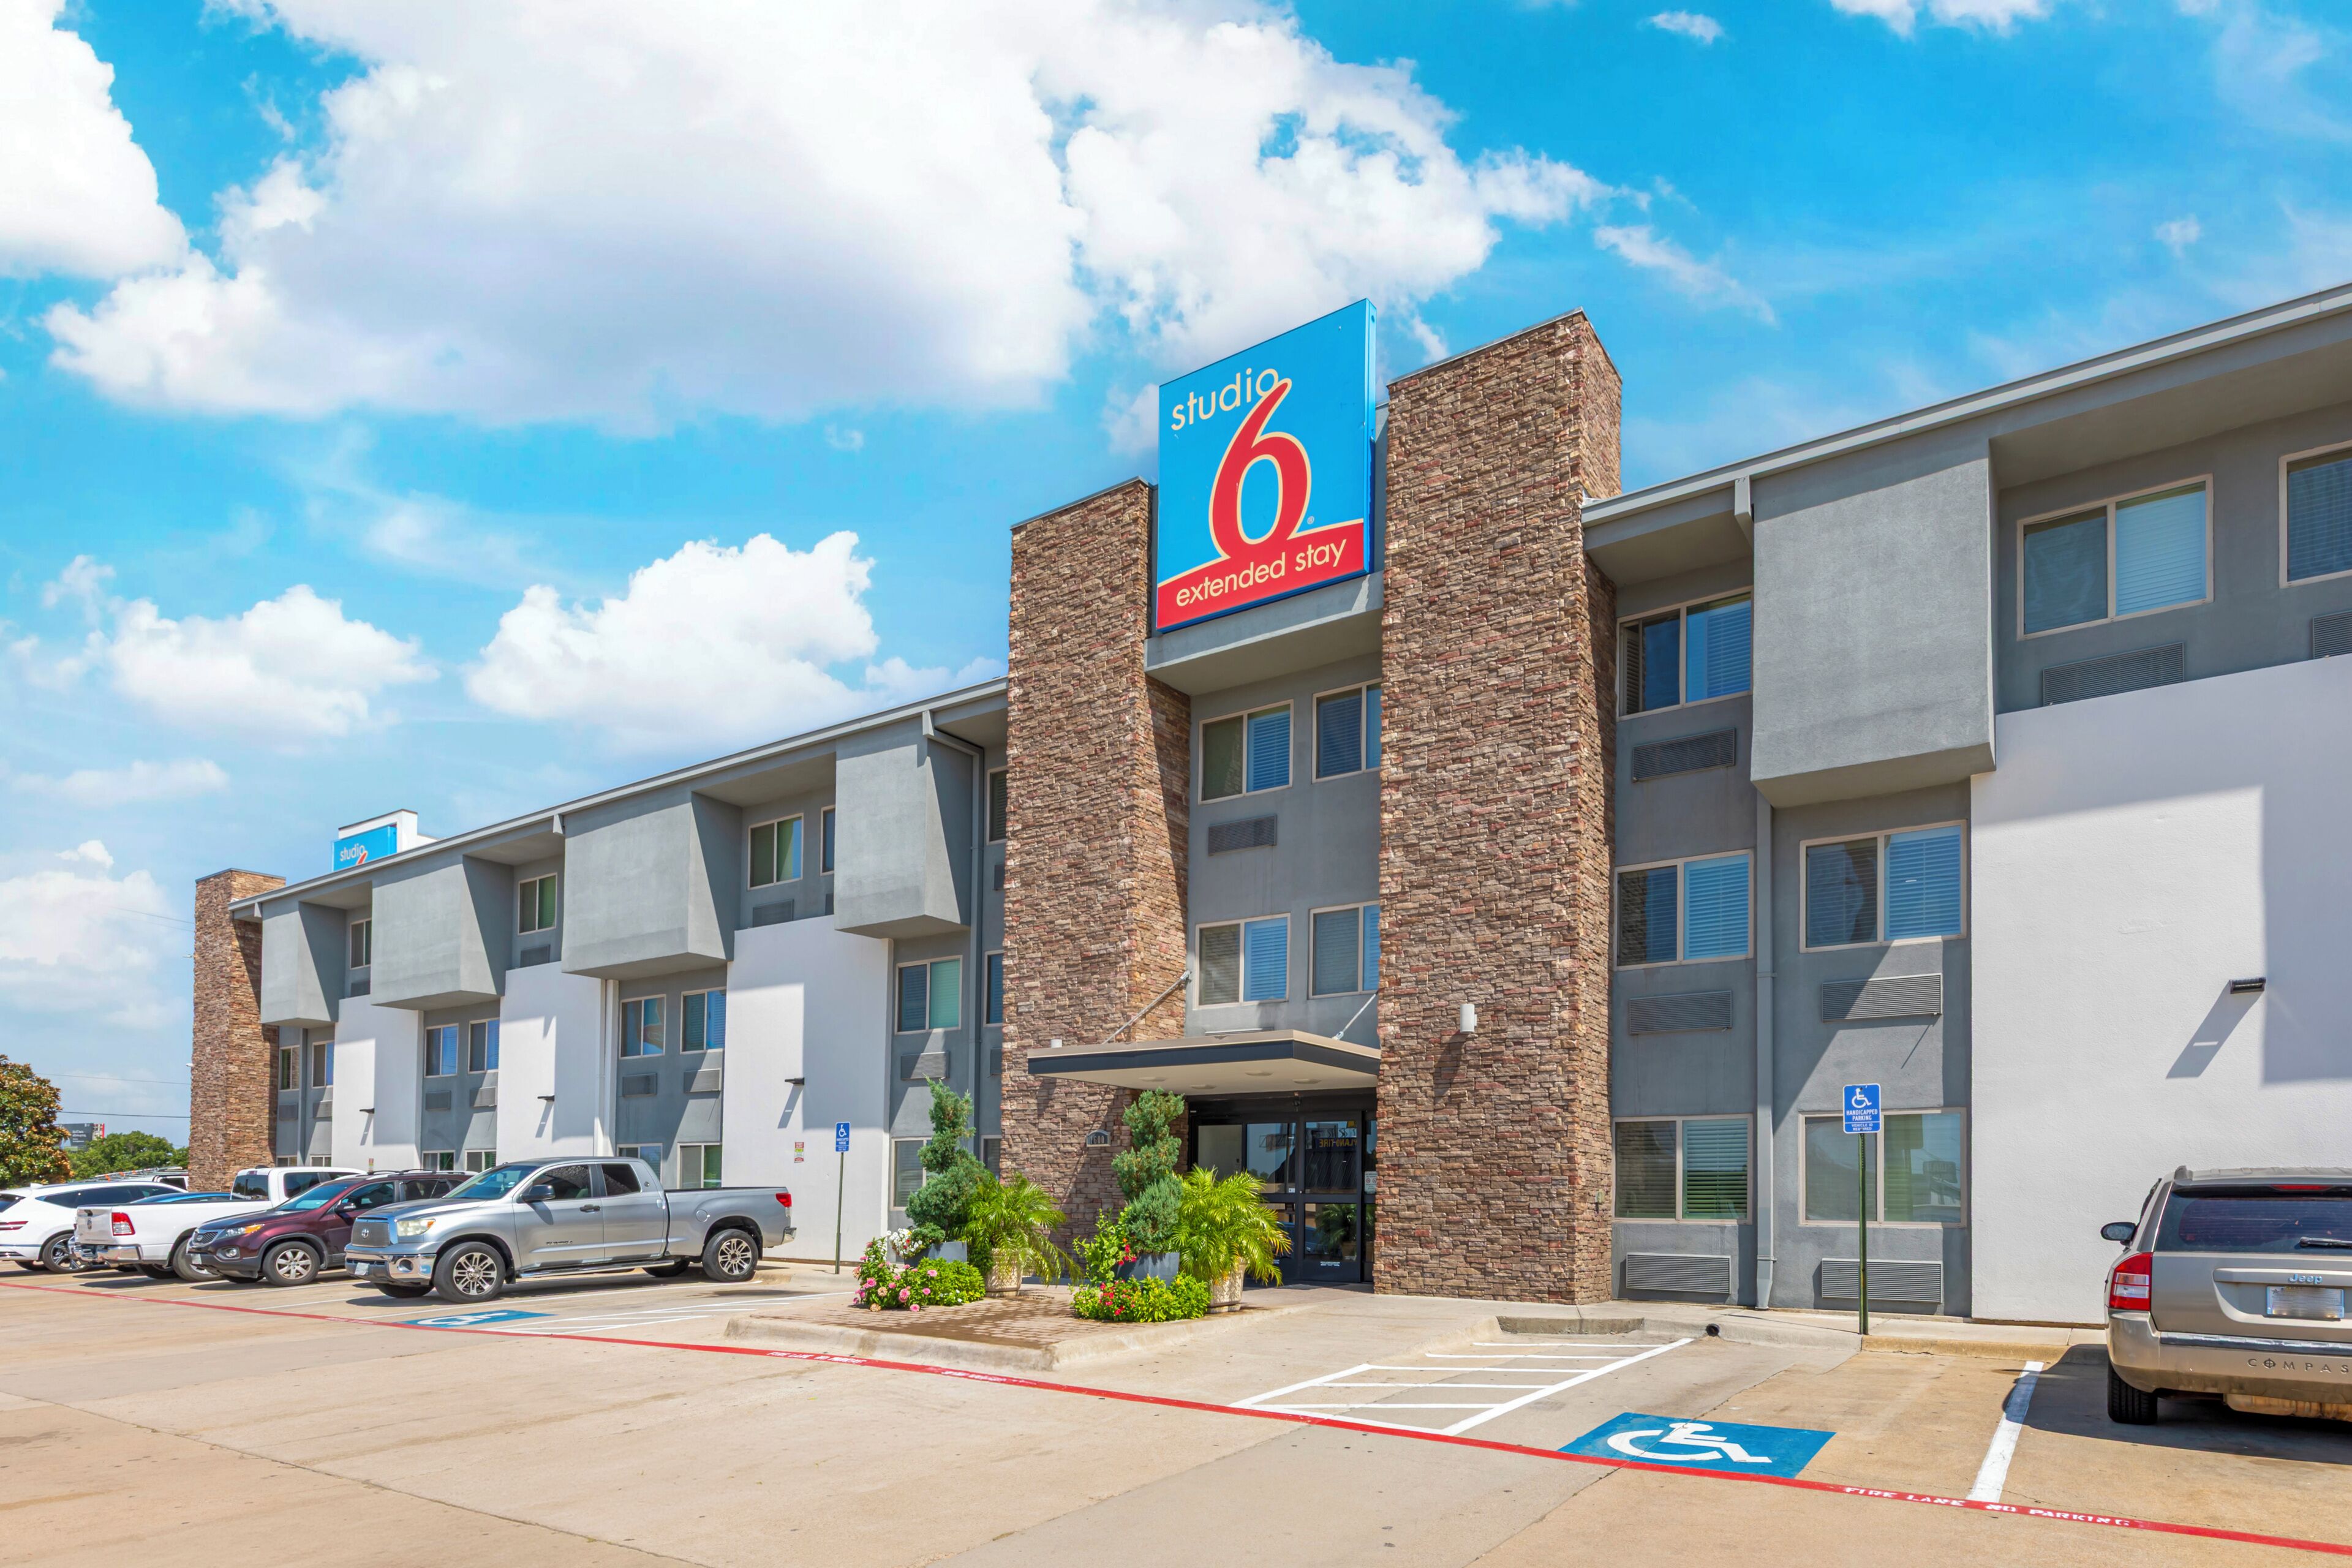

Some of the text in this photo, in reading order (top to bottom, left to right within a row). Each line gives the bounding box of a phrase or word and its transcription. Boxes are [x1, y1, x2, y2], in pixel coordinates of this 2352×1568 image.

[1170, 368, 1280, 431] studio
[1208, 377, 1311, 556] 6
[1175, 538, 1347, 607] extended stay
[339, 843, 365, 862] studio
[2288, 1273, 2323, 1284] Jeep
[1844, 1487, 2130, 1526] FIRE LANE NO PARKING
